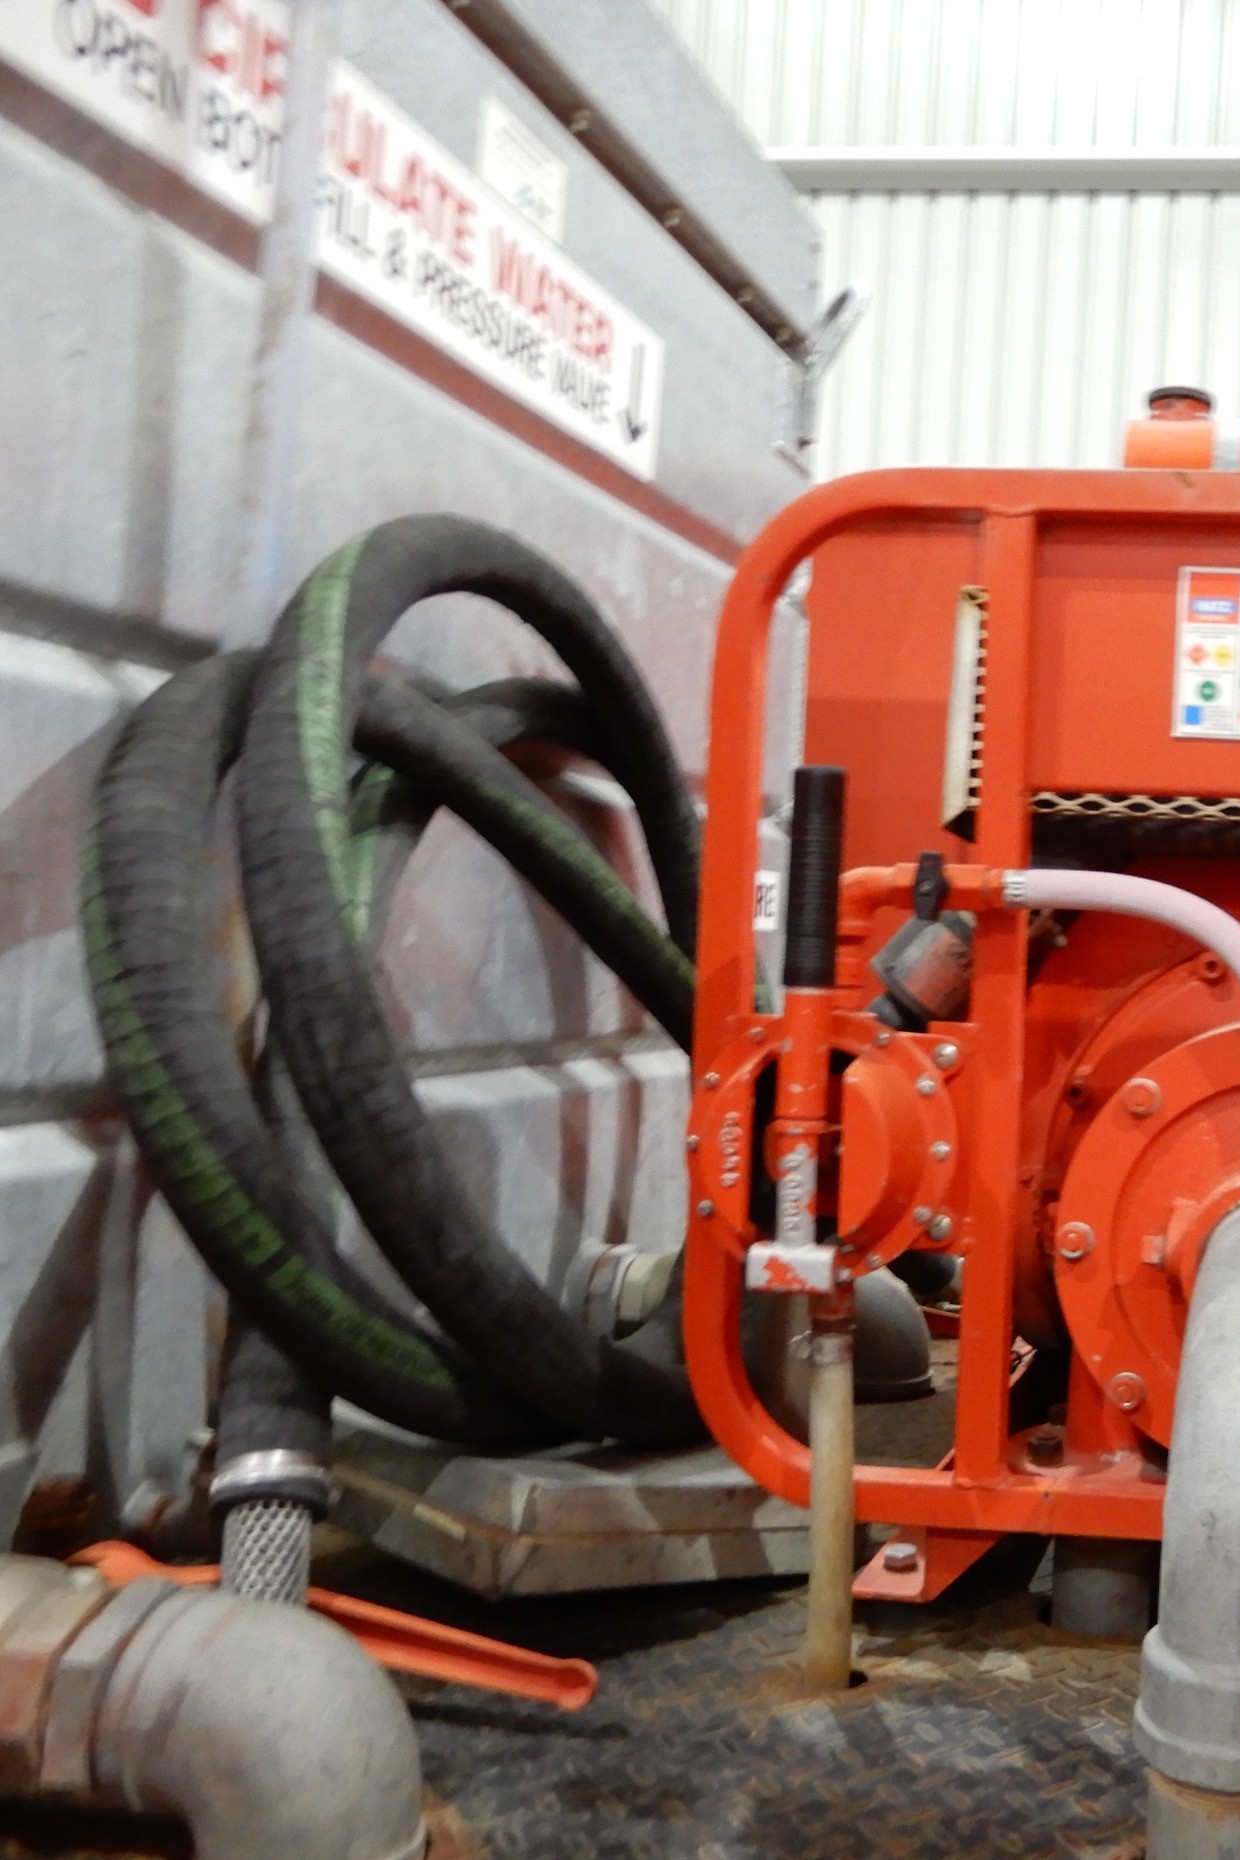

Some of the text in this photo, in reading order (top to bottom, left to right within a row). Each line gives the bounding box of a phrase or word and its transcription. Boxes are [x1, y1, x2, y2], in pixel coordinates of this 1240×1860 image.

[53, 0, 190, 125] OPEN
[382, 226, 408, 284] &
[412, 247, 547, 382] PRESSURE
[549, 346, 612, 427] VALVE
[488, 222, 615, 375] WATER
